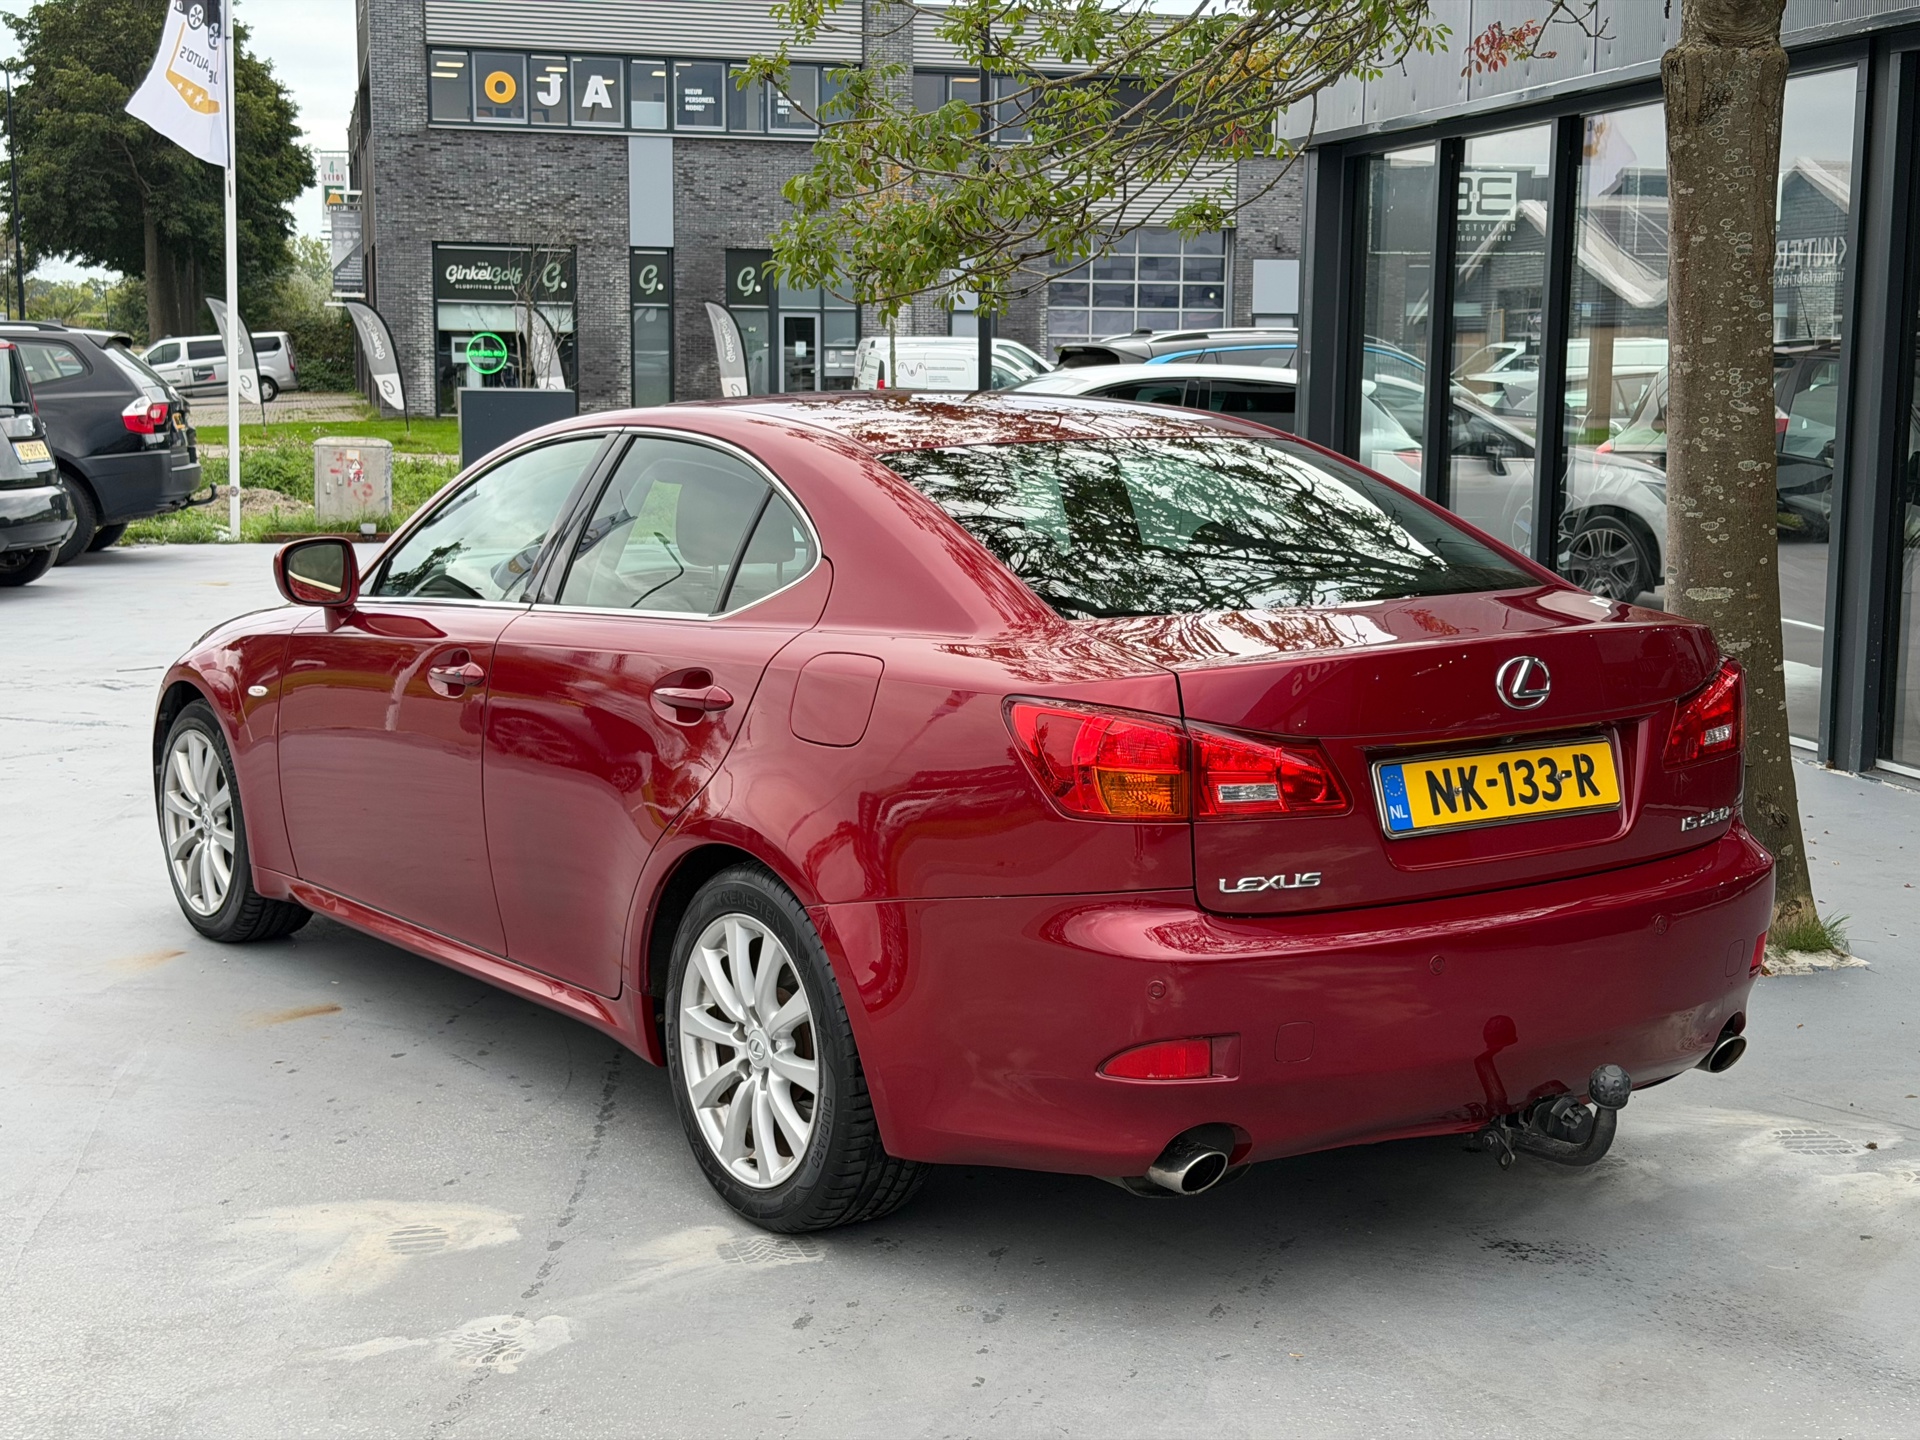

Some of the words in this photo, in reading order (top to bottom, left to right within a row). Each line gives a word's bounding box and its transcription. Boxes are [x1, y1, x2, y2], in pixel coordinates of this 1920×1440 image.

[445, 263, 523, 285] GinkelGolf
[1425, 753, 1600, 816] NK-133-R
[1389, 804, 1409, 820] NL
[1219, 872, 1322, 893] LEXUS
